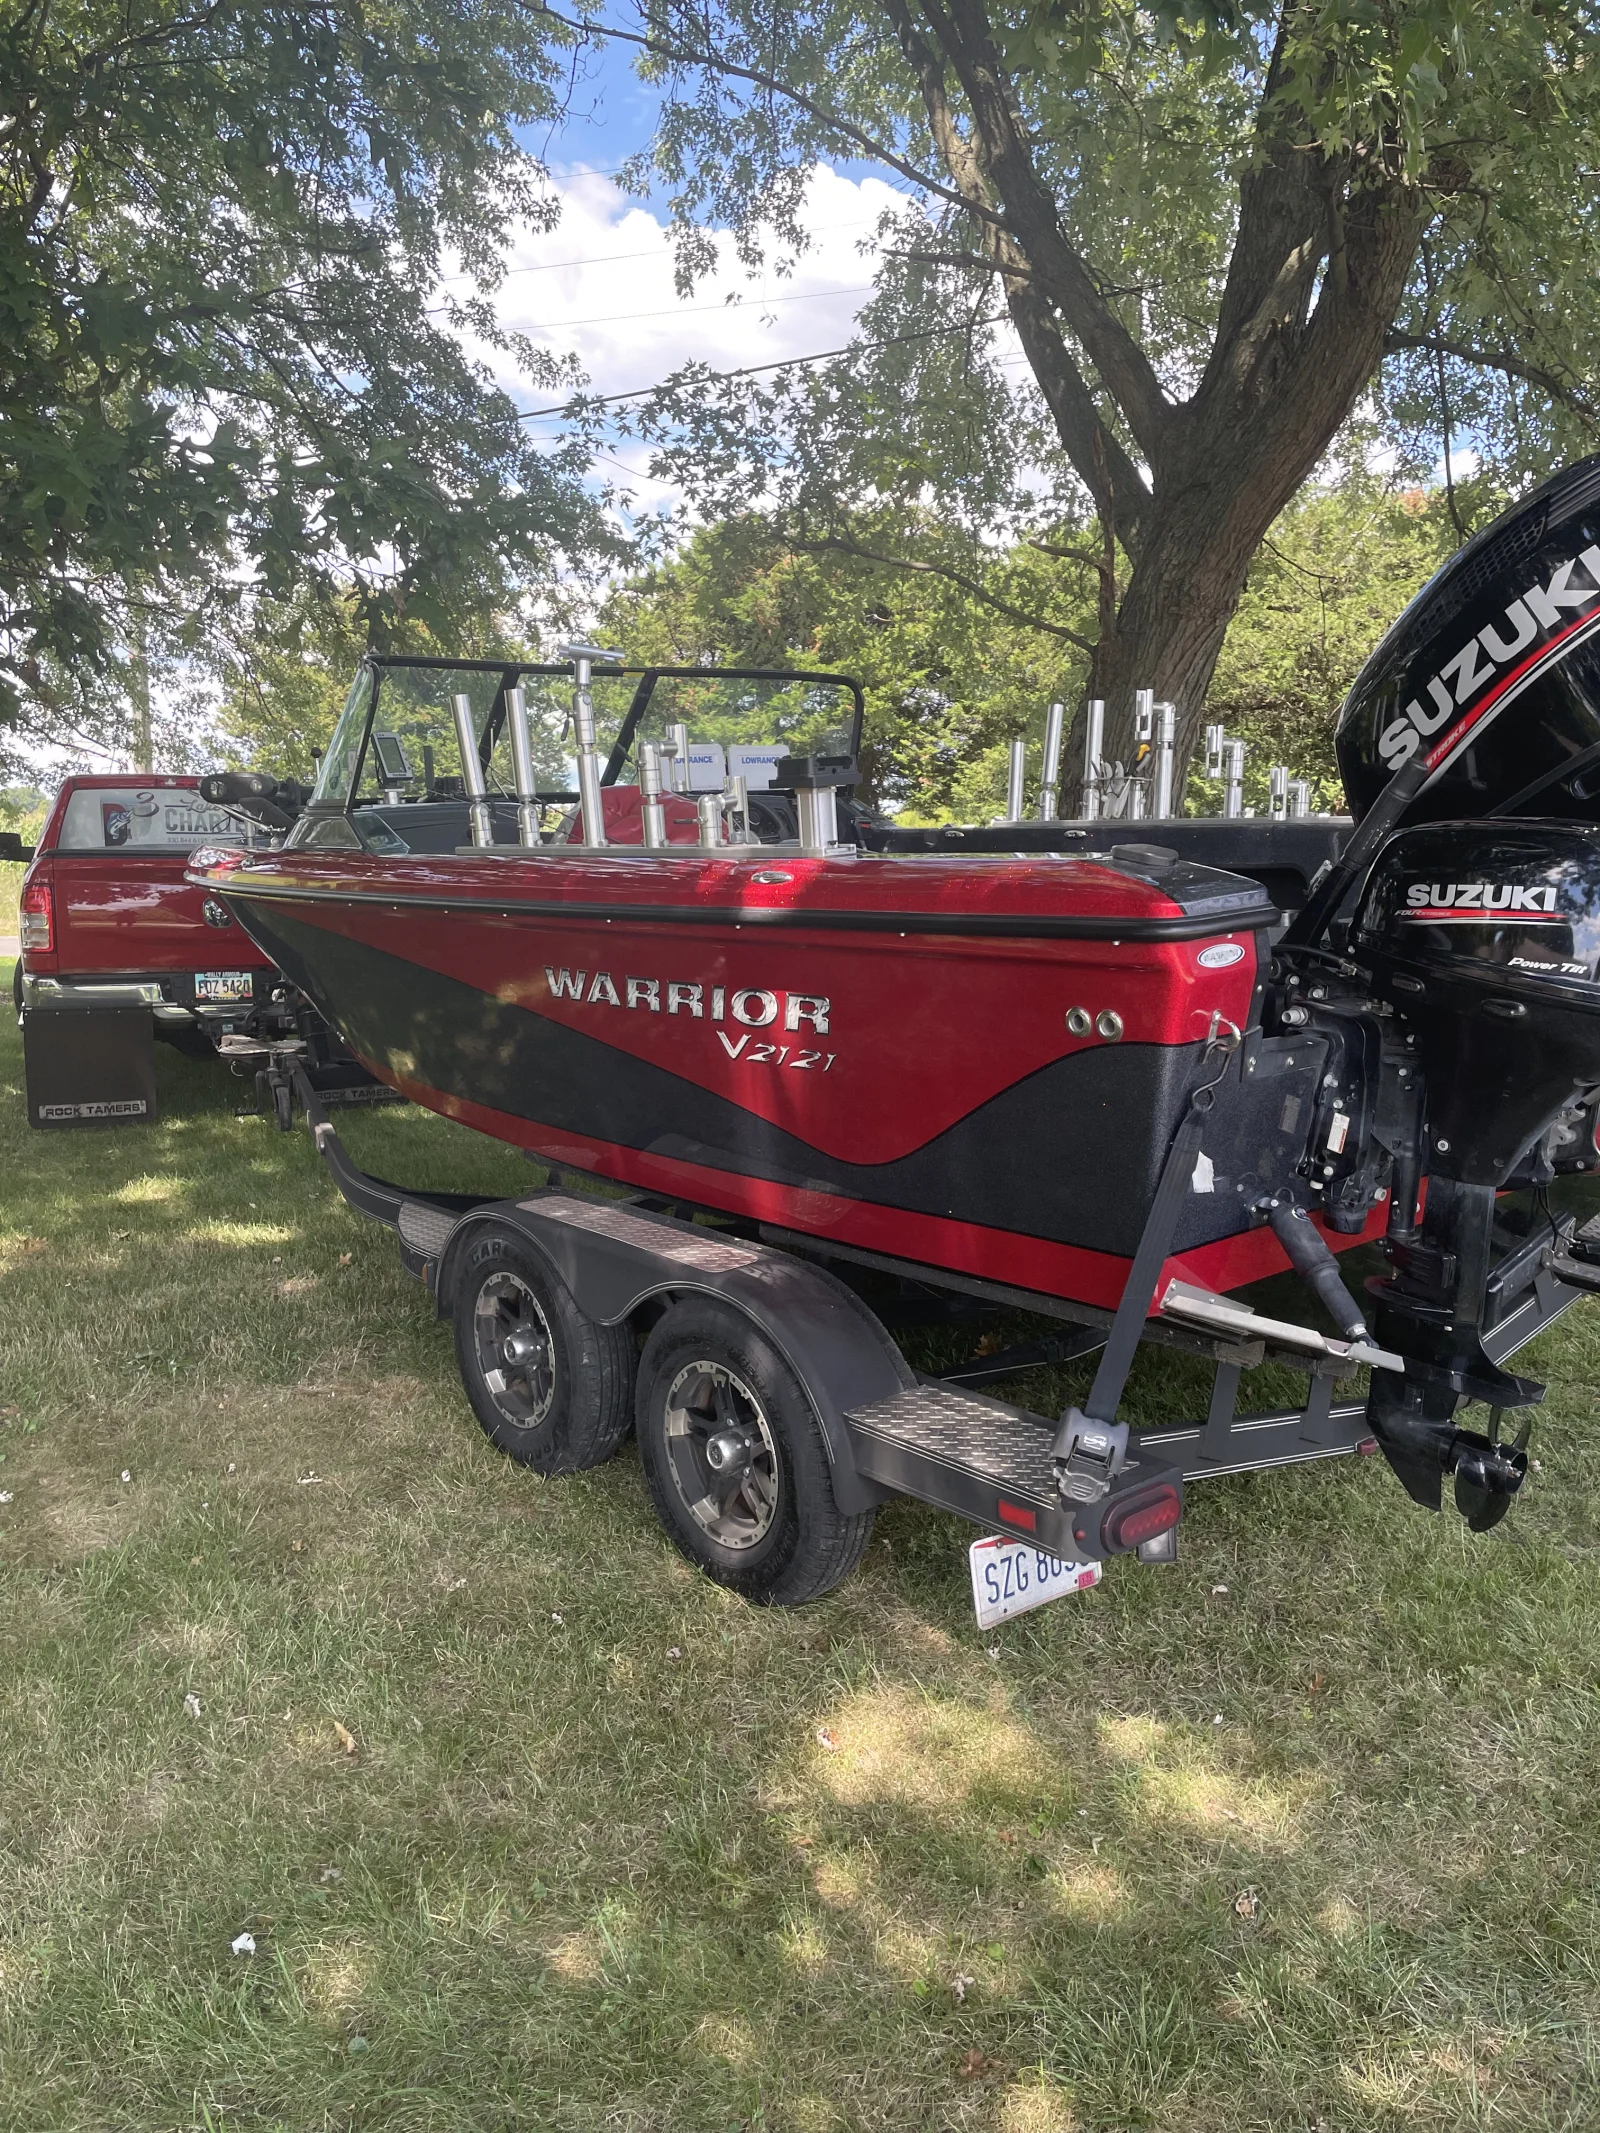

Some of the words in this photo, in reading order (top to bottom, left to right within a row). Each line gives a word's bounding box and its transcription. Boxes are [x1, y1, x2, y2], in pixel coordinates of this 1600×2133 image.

[1378, 544, 1600, 771] SUZUKI
[741, 756, 779, 764] LOWRANC
[1406, 884, 1557, 912] SUZUKI
[1507, 957, 1559, 970] Power
[1560, 962, 1588, 974] Tilt
[544, 965, 831, 1035] WARRIOR
[716, 1030, 837, 1072] V2121
[45, 1107, 82, 1117] ROCK
[86, 1103, 140, 1114] TAMERS
[985, 1551, 1028, 1604] SZG
